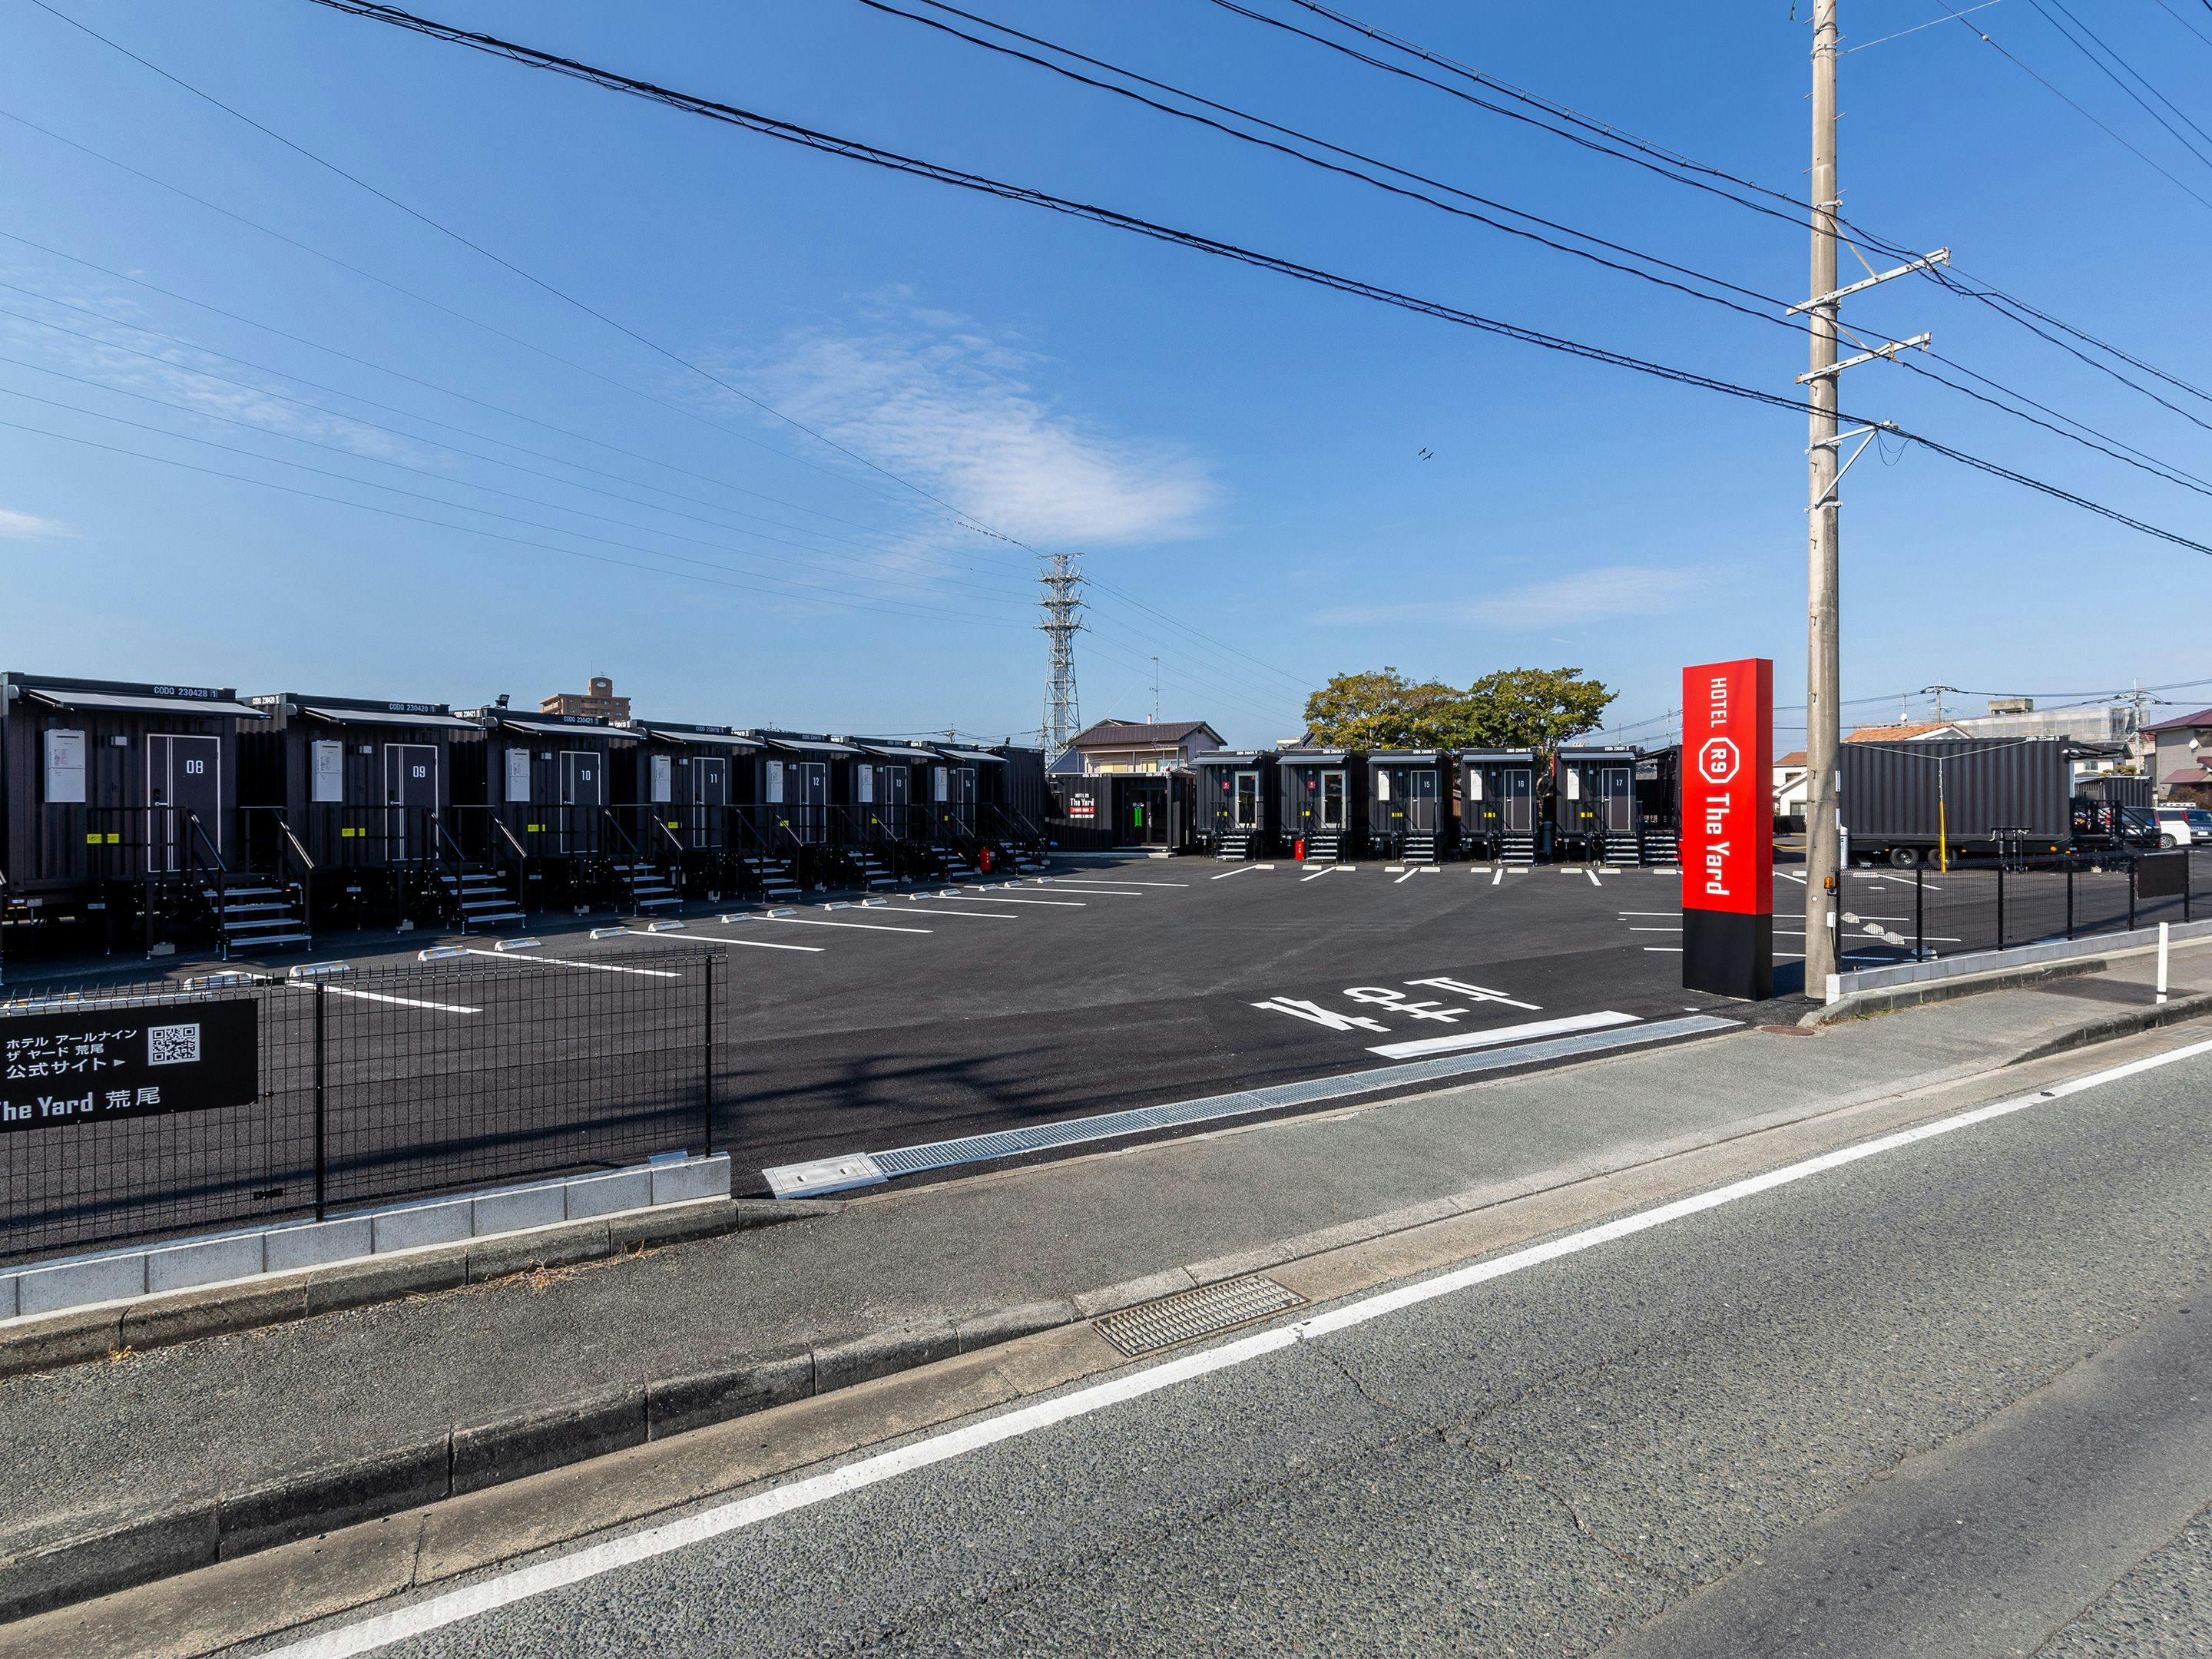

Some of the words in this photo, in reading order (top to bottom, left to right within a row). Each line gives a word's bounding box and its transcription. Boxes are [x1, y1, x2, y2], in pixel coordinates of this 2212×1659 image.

[154, 686, 175, 695] CODQ
[178, 688, 208, 697] 230428
[1710, 677, 1727, 728] HOTEL
[187, 760, 204, 773] 08
[1710, 748, 1727, 773] R9
[413, 766, 426, 777] 09
[581, 770, 591, 780] 10
[710, 773, 717, 783] 11
[813, 777, 820, 786] 12
[896, 779, 902, 787] 13
[1706, 793, 1730, 835] The
[1706, 842, 1730, 896] Yard
[1250, 977, 1544, 1032] 止まれ
[6, 1037, 48, 1049] ホテル
[55, 1030, 137, 1045] アールナイン
[6, 1051, 21, 1061] ザ
[28, 1047, 69, 1060] ヤード
[75, 1043, 104, 1055] 荒尾
[6, 1058, 107, 1079] 公式サイト
[0, 1101, 32, 1121] he
[38, 1091, 94, 1117] Yard
[106, 1086, 161, 1109] 荒尾
